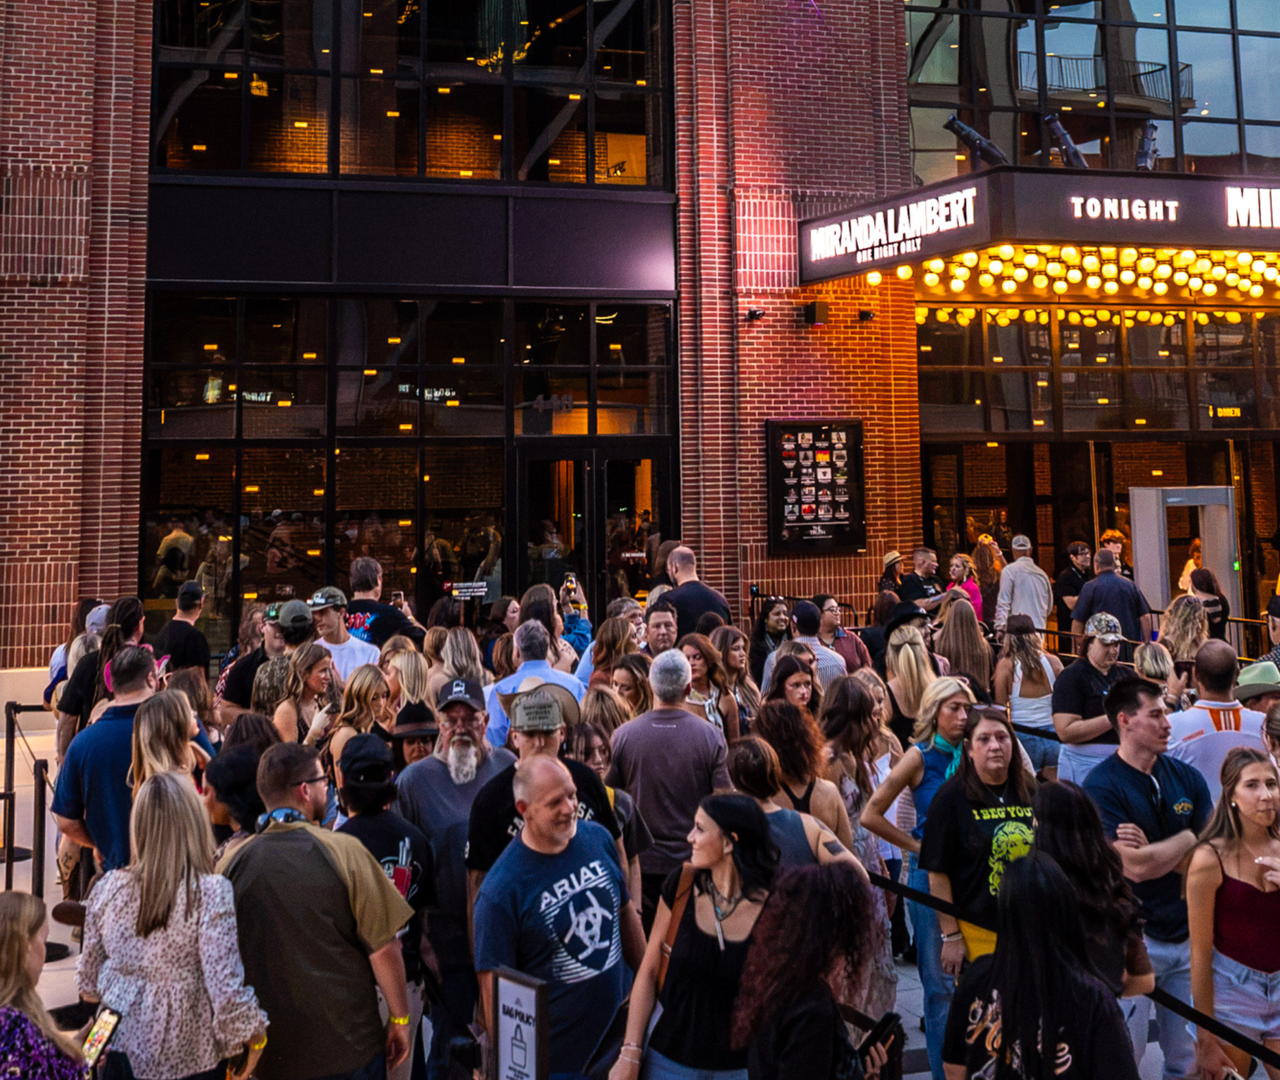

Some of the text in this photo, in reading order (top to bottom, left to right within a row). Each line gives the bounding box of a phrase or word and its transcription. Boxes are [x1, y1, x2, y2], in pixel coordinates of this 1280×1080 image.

[1071, 196, 1179, 221] TONIGHT
[810, 187, 977, 262] MIRANDA LAMBERT
[856, 236, 922, 264] ONE NIGHT ONLY
[972, 809, 980, 820] I
[980, 807, 1006, 820] BEG
[540, 860, 604, 912] ARIAT
